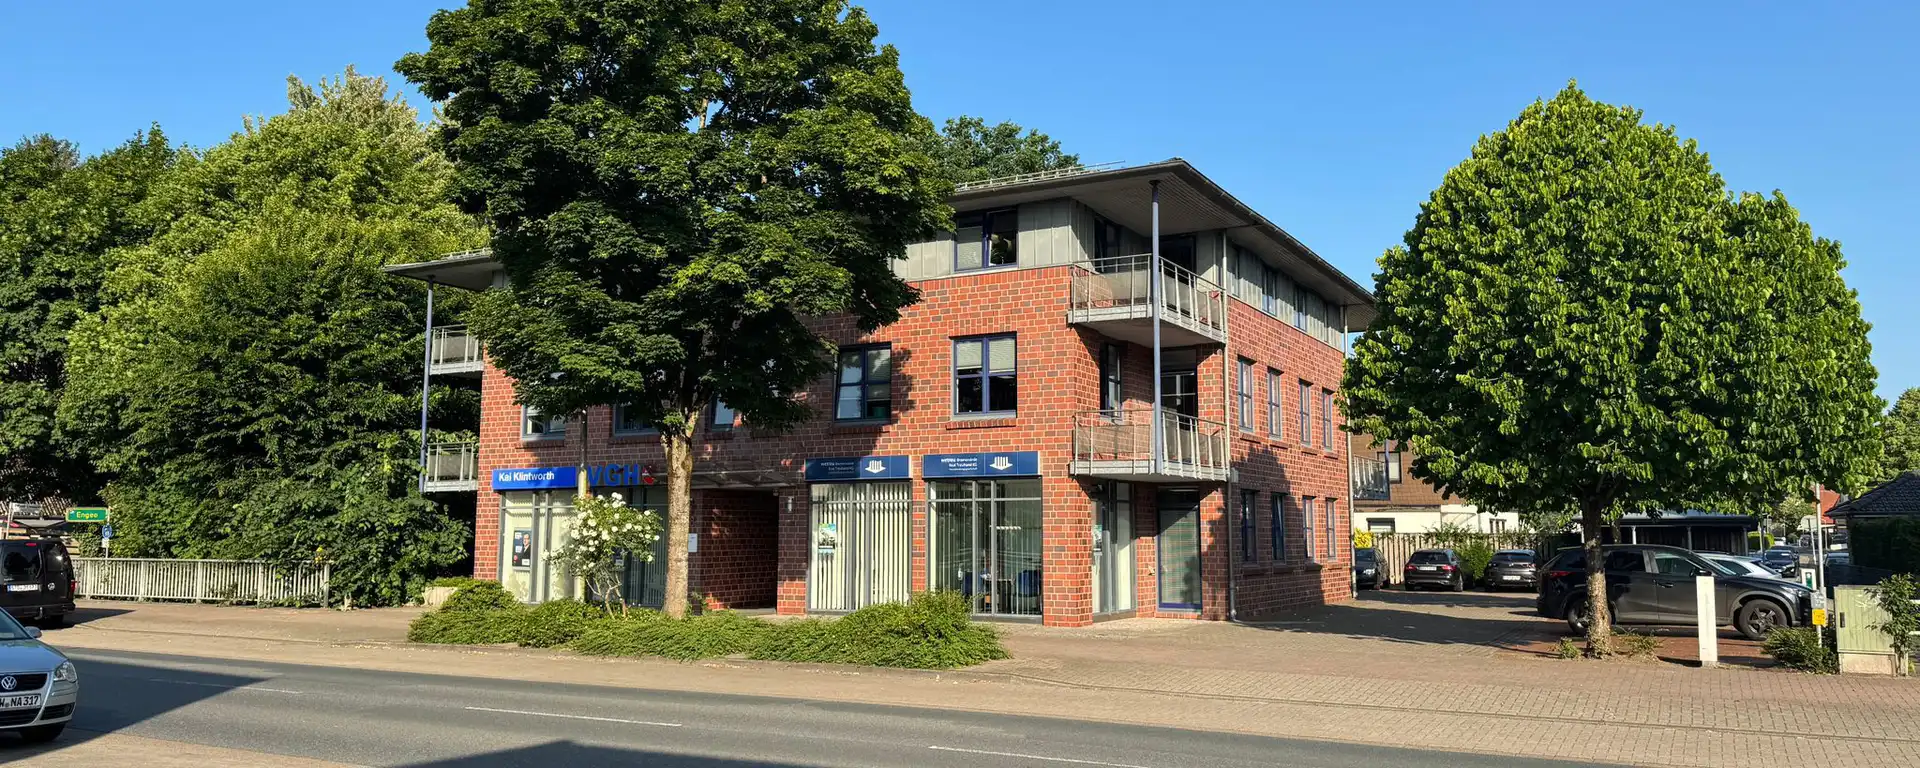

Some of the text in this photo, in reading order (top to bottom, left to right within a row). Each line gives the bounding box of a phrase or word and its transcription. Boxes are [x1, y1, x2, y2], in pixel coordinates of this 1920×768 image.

[499, 471, 555, 482] Kai Klintworth
[588, 464, 639, 486] VGH
[76, 511, 98, 520] Engeo
[11, 697, 22, 707] NA
[23, 696, 39, 706] 317
